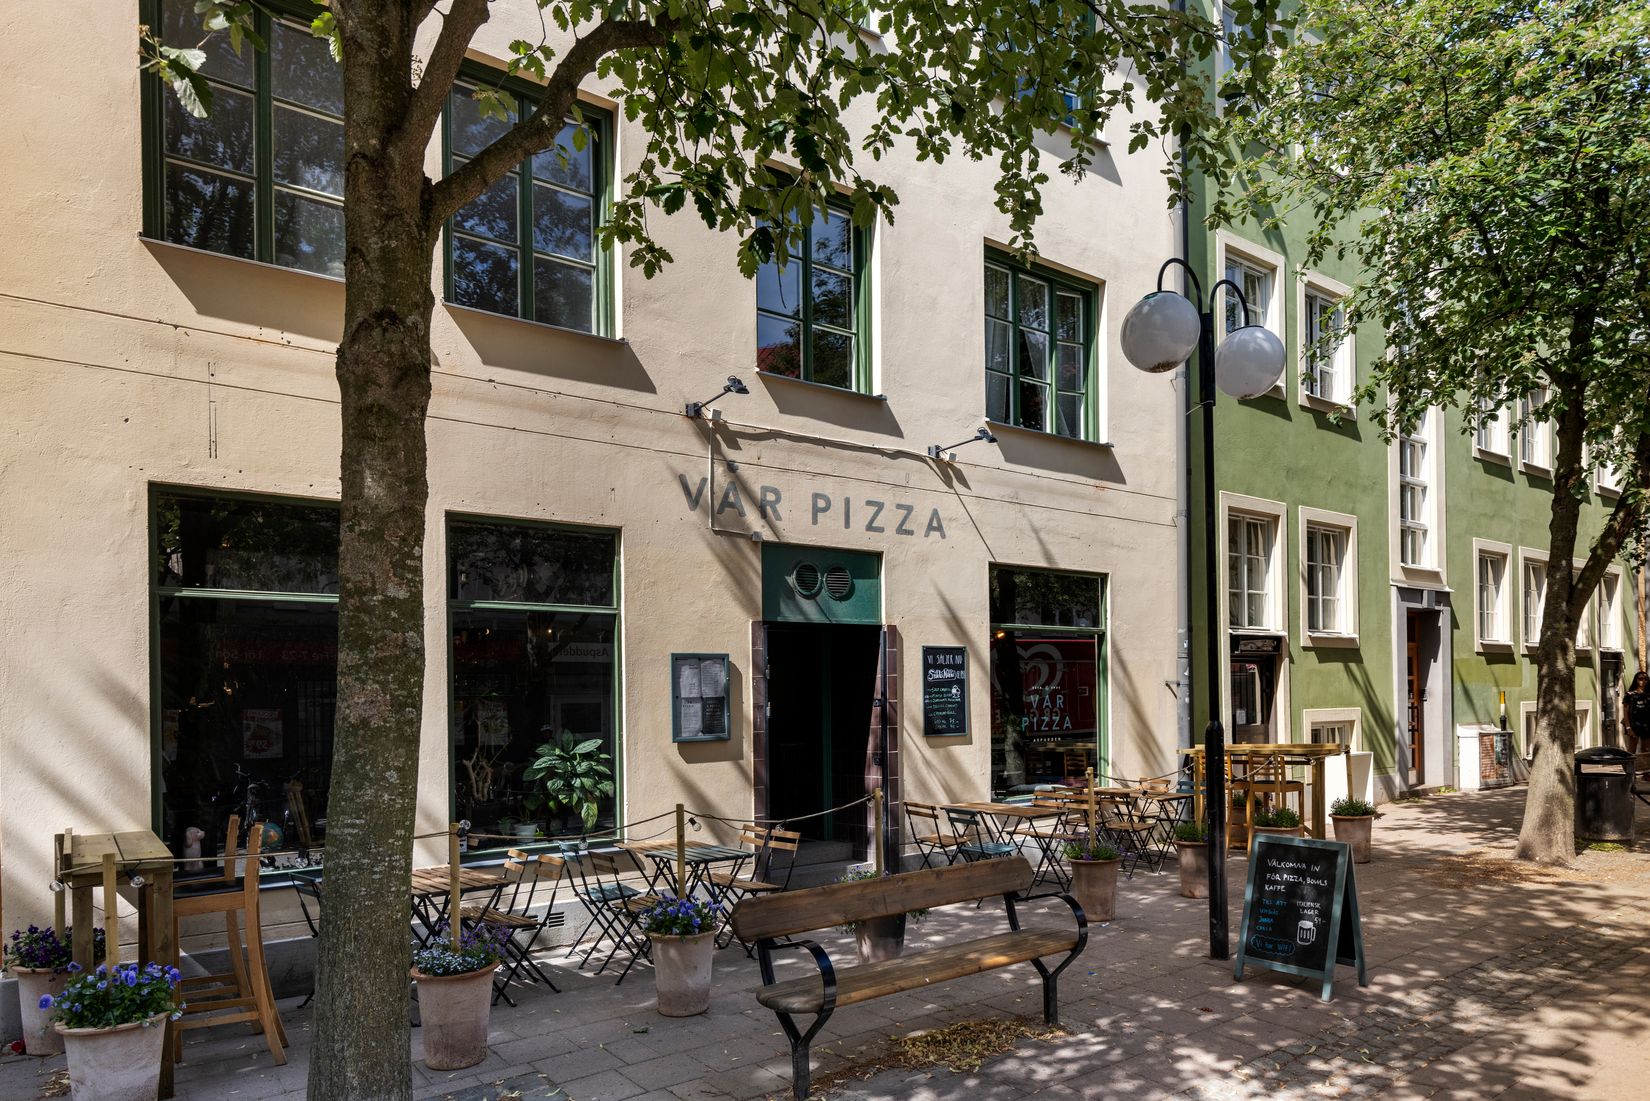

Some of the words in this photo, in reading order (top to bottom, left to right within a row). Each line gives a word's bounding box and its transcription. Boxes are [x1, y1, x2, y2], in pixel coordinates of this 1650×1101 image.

[811, 493, 947, 540] PIZZA
[1022, 716, 1072, 732] PIZZA
[1267, 858, 1307, 870] VÄLKOMNA
[1310, 864, 1321, 872] IN
[1266, 873, 1281, 881] FÖR
[1306, 877, 1328, 887] BOWLS
[1264, 884, 1287, 892] KAFFE
[1275, 899, 1288, 907] ATT
[1296, 900, 1322, 909] ITALIENSK
